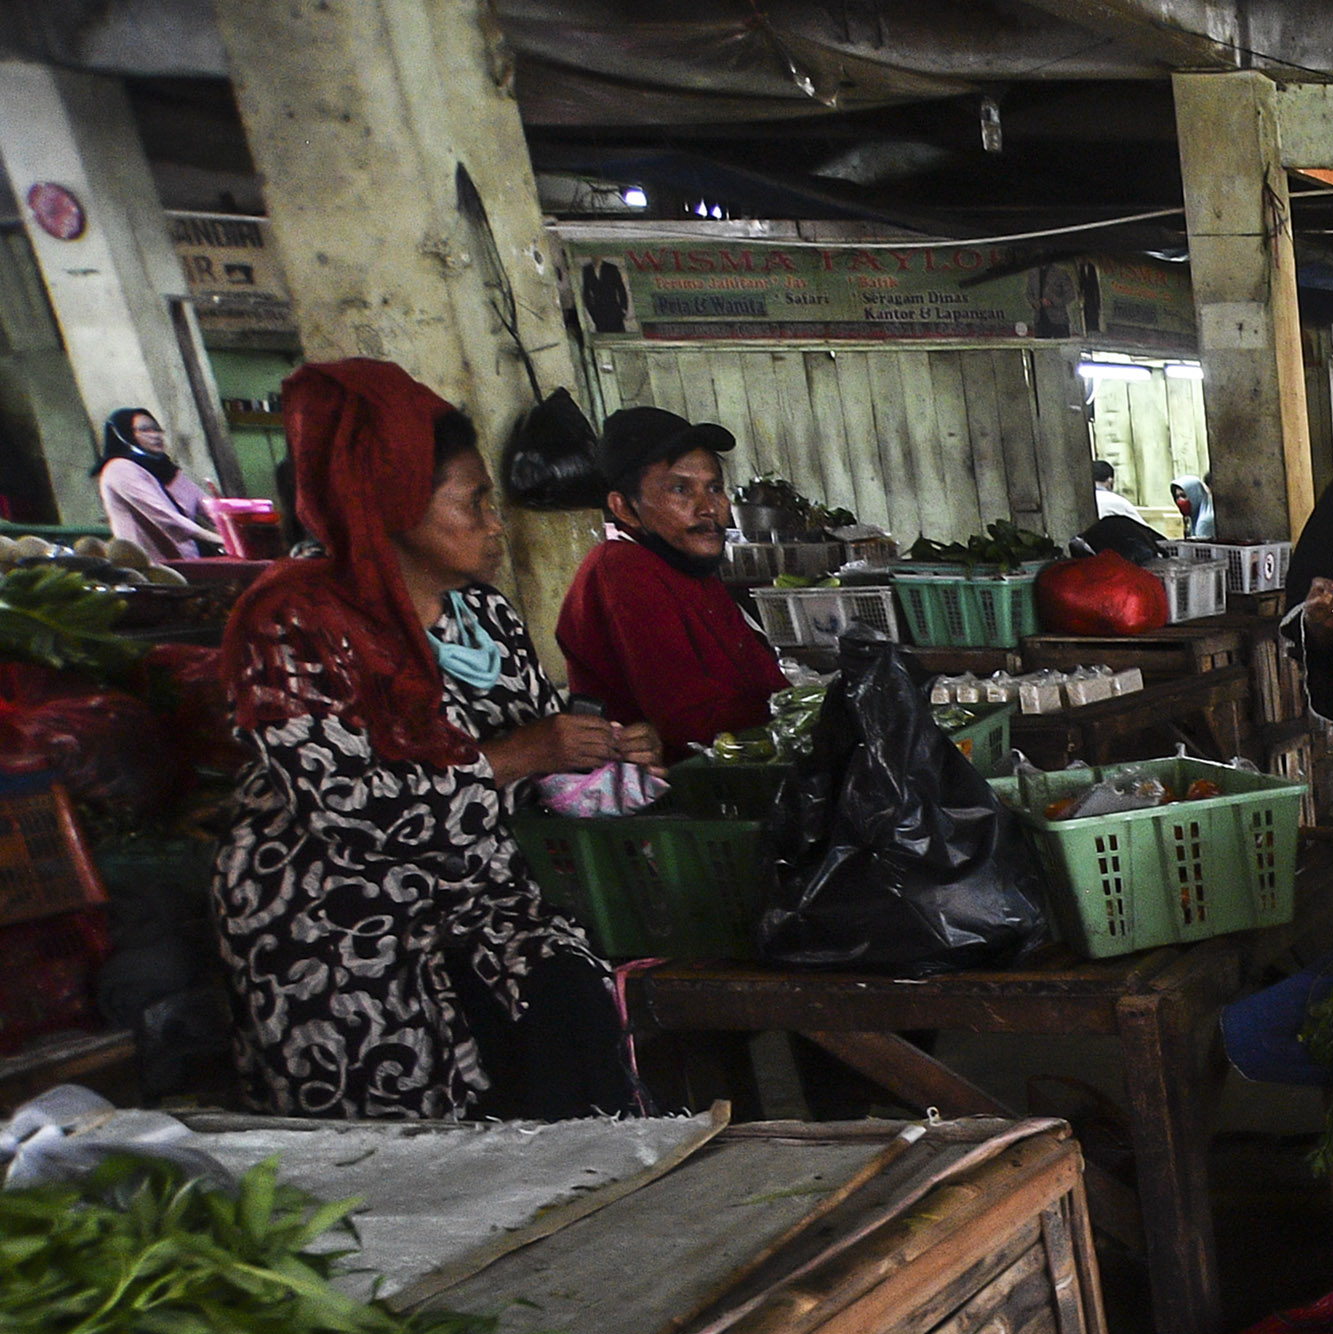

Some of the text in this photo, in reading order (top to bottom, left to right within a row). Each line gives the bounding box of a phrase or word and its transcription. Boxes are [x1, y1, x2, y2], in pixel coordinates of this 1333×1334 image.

[171, 219, 264, 248] ANDIRI
[626, 246, 797, 273] WISMA
[711, 296, 767, 316] Wanita
[785, 293, 830, 305] Safari
[862, 292, 923, 307] Seragam
[864, 308, 916, 321] Kantor
[936, 309, 1005, 324] Lapangan
